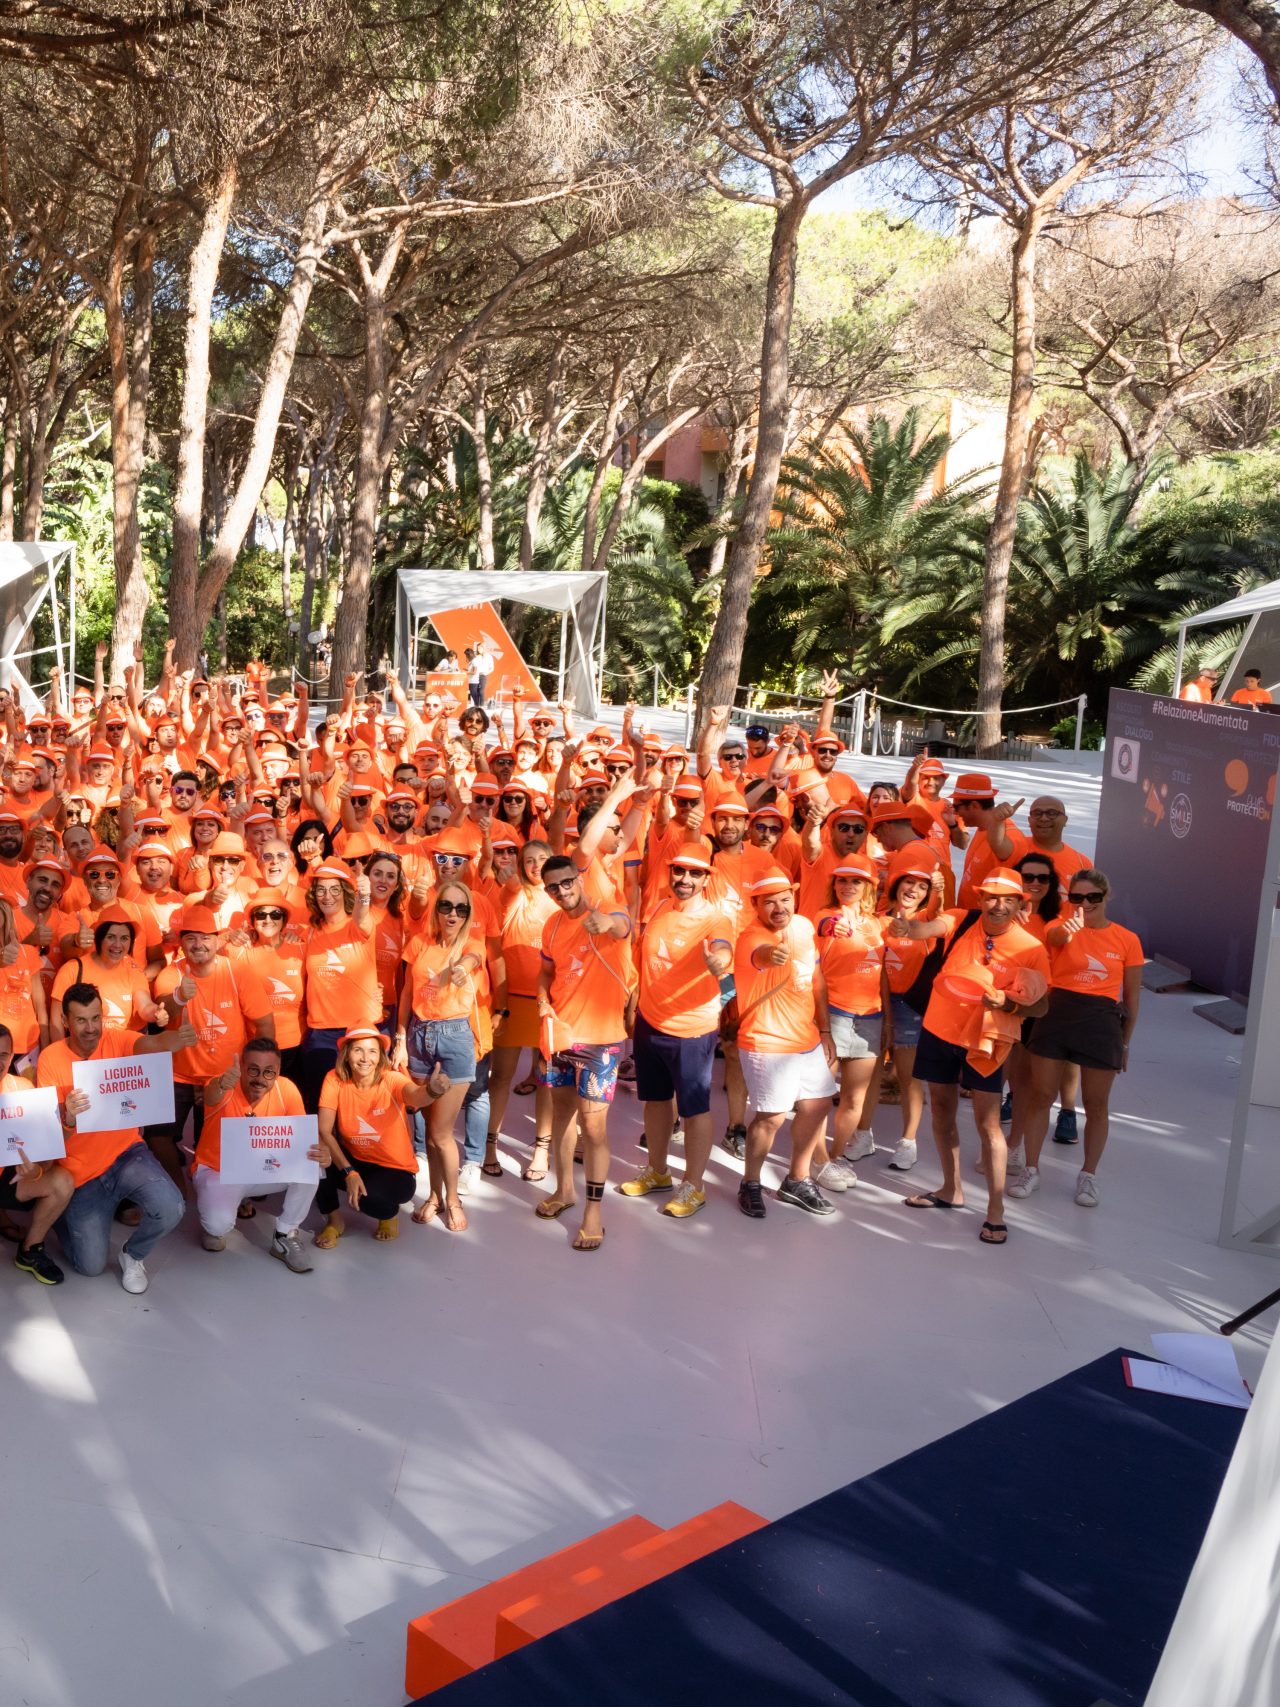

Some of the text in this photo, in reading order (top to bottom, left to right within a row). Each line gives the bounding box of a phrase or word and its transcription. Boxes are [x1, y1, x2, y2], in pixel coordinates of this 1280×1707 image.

[1152, 700, 1249, 731] #RelazioneAumentata
[1124, 725, 1154, 741] DIALOGO
[1171, 770, 1192, 785] STILE
[104, 1065, 144, 1081] LIGURIA
[99, 1078, 151, 1095] SARDEGNA
[249, 1125, 294, 1137] TOSCANA
[251, 1138, 291, 1149] UMBRIA
